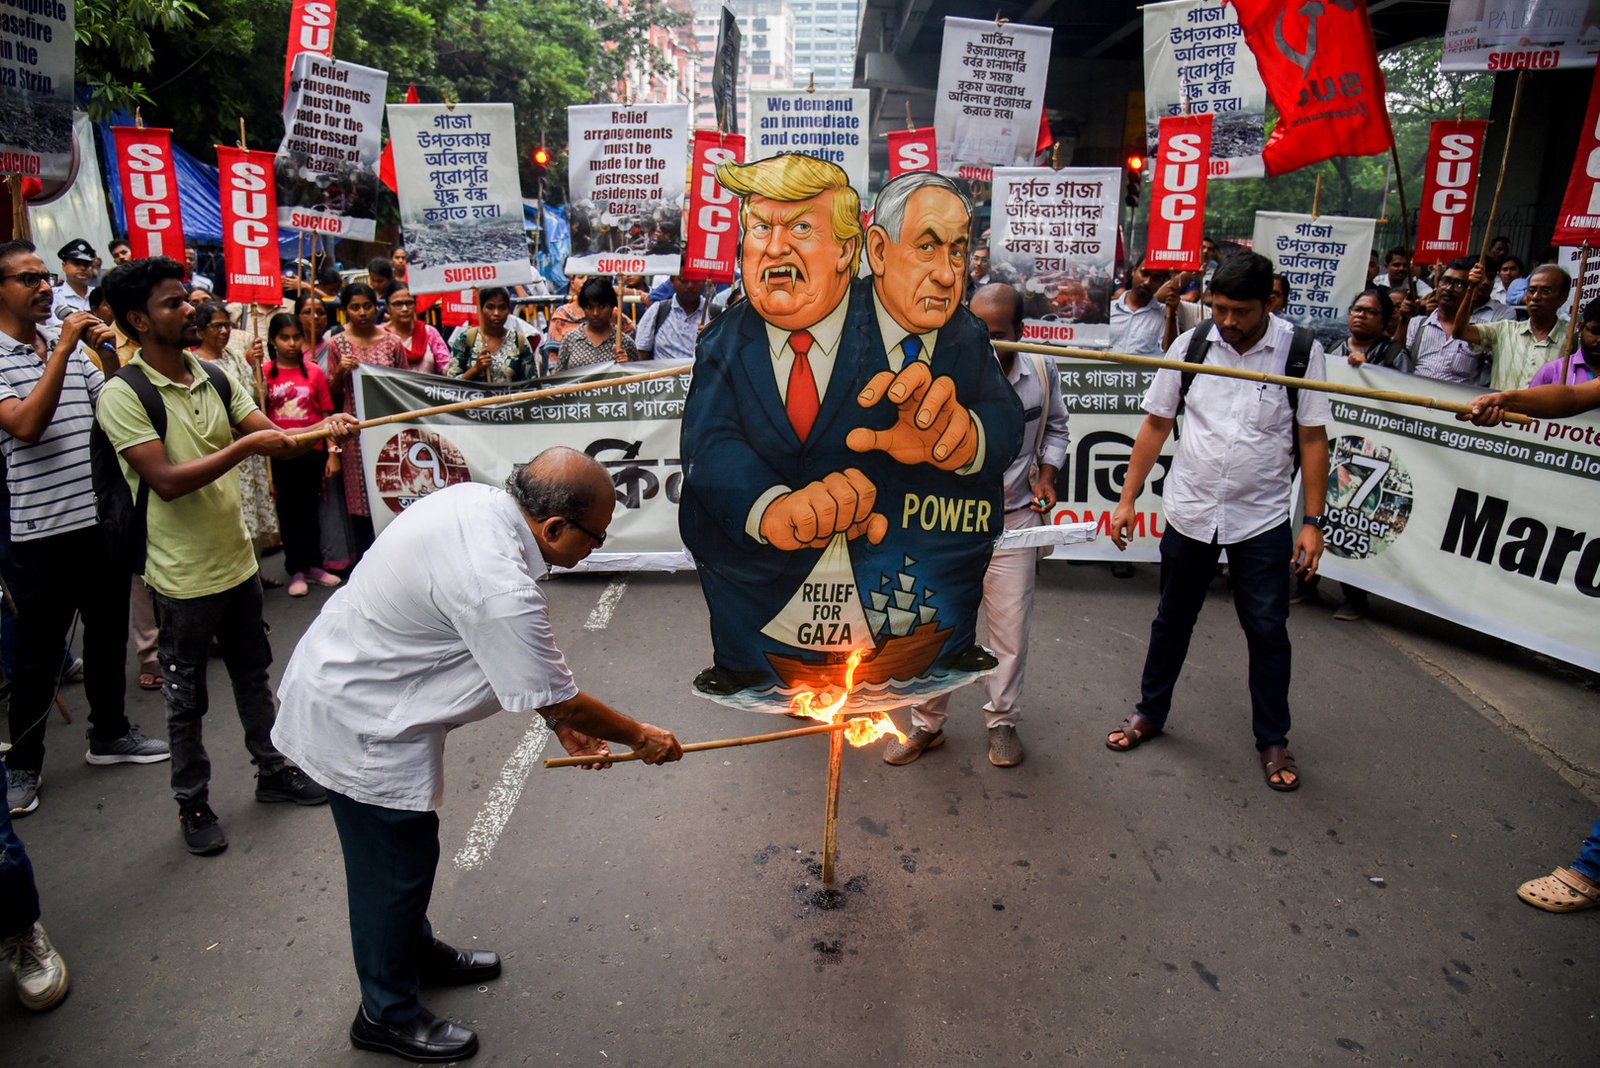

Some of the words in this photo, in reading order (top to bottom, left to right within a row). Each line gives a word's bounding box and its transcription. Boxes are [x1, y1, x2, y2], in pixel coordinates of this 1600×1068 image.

[1187, 6, 1226, 23] গাজা
[0, 13, 52, 43] asefire
[16, 41, 38, 66] the
[1174, 42, 1237, 61] অবিলম্বে
[0, 67, 17, 88] za
[311, 62, 350, 87] Relief
[973, 69, 987, 80] সহ
[957, 80, 984, 92] রকম
[1207, 80, 1232, 95] বন্ধ
[303, 93, 333, 112] must
[335, 99, 351, 115] be
[767, 98, 790, 111] We
[794, 98, 853, 111] demand
[948, 90, 991, 106] অবিলম্বে
[612, 111, 648, 124] Relief
[963, 105, 992, 117] করতে
[1168, 101, 1209, 116] কতে
[324, 113, 342, 128] for
[344, 115, 363, 133] the
[434, 114, 472, 130] গাজা
[760, 116, 778, 129] an
[782, 114, 859, 129] immediate
[293, 123, 357, 147] distressed
[417, 131, 491, 149] উপত্যকায়
[584, 127, 673, 141] arrangements
[761, 131, 788, 145] and
[792, 131, 859, 146] complete
[288, 138, 345, 160] residents
[347, 149, 360, 163] of
[604, 143, 633, 155] must
[636, 142, 652, 154] be
[424, 149, 488, 167] অবিলম্বে
[590, 158, 621, 171] made
[624, 158, 643, 169] for
[645, 157, 666, 169] the
[430, 165, 488, 189] পুরোপুরি
[596, 172, 659, 186] distressed
[592, 187, 647, 200] residents
[650, 187, 663, 200] of
[1055, 181, 1103, 199] গাজা
[1160, 134, 1201, 250] SUCI
[1433, 134, 1474, 240] SUCI
[433, 189, 459, 207] যুদ্ধ
[463, 188, 487, 201] বন্ধ
[231, 162, 269, 275] SUCI
[423, 206, 467, 221] করতে
[1295, 223, 1333, 238] গাজা
[1054, 241, 1101, 255] করতে
[1276, 236, 1347, 257] উপত্যকায়
[1279, 252, 1340, 271] অবিলম্বে
[1306, 289, 1330, 303] বন্ধ
[1059, 371, 1080, 388] বং
[1085, 369, 1138, 388] গাজায়
[465, 404, 524, 422] অবরোধ
[530, 402, 591, 421] প্রত্যাহার
[596, 400, 628, 417] করে
[1334, 403, 1357, 420] the
[1360, 408, 1438, 440] imperialist
[1440, 429, 1531, 460] aggression
[1534, 450, 1568, 468] and
[1347, 455, 1390, 510] 7
[902, 493, 992, 533] POWER
[1323, 525, 1369, 554] 2025
[802, 583, 855, 603] RELIEF
[812, 604, 842, 621] FOR
[797, 622, 852, 646] GAZA
